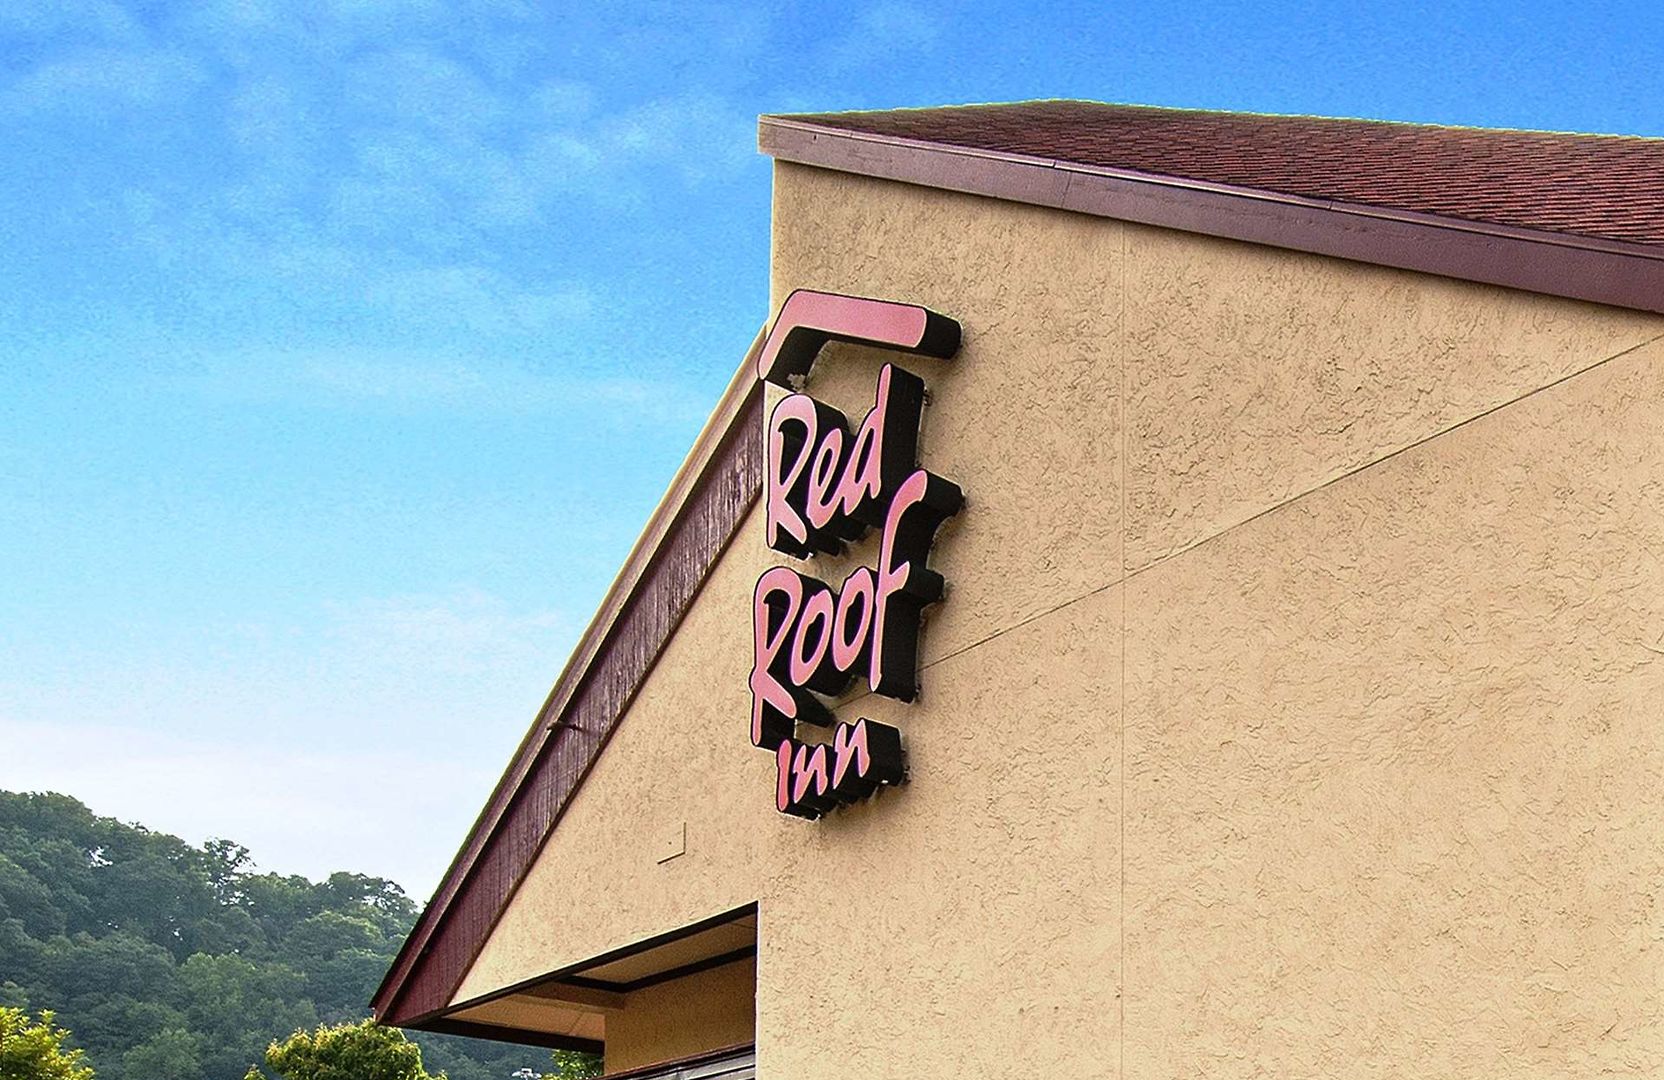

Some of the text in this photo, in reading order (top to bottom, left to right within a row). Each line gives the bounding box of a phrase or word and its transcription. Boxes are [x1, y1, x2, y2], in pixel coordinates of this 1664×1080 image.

[767, 362, 892, 549] Red
[750, 468, 928, 746] Roof
[776, 717, 871, 812] Inn
